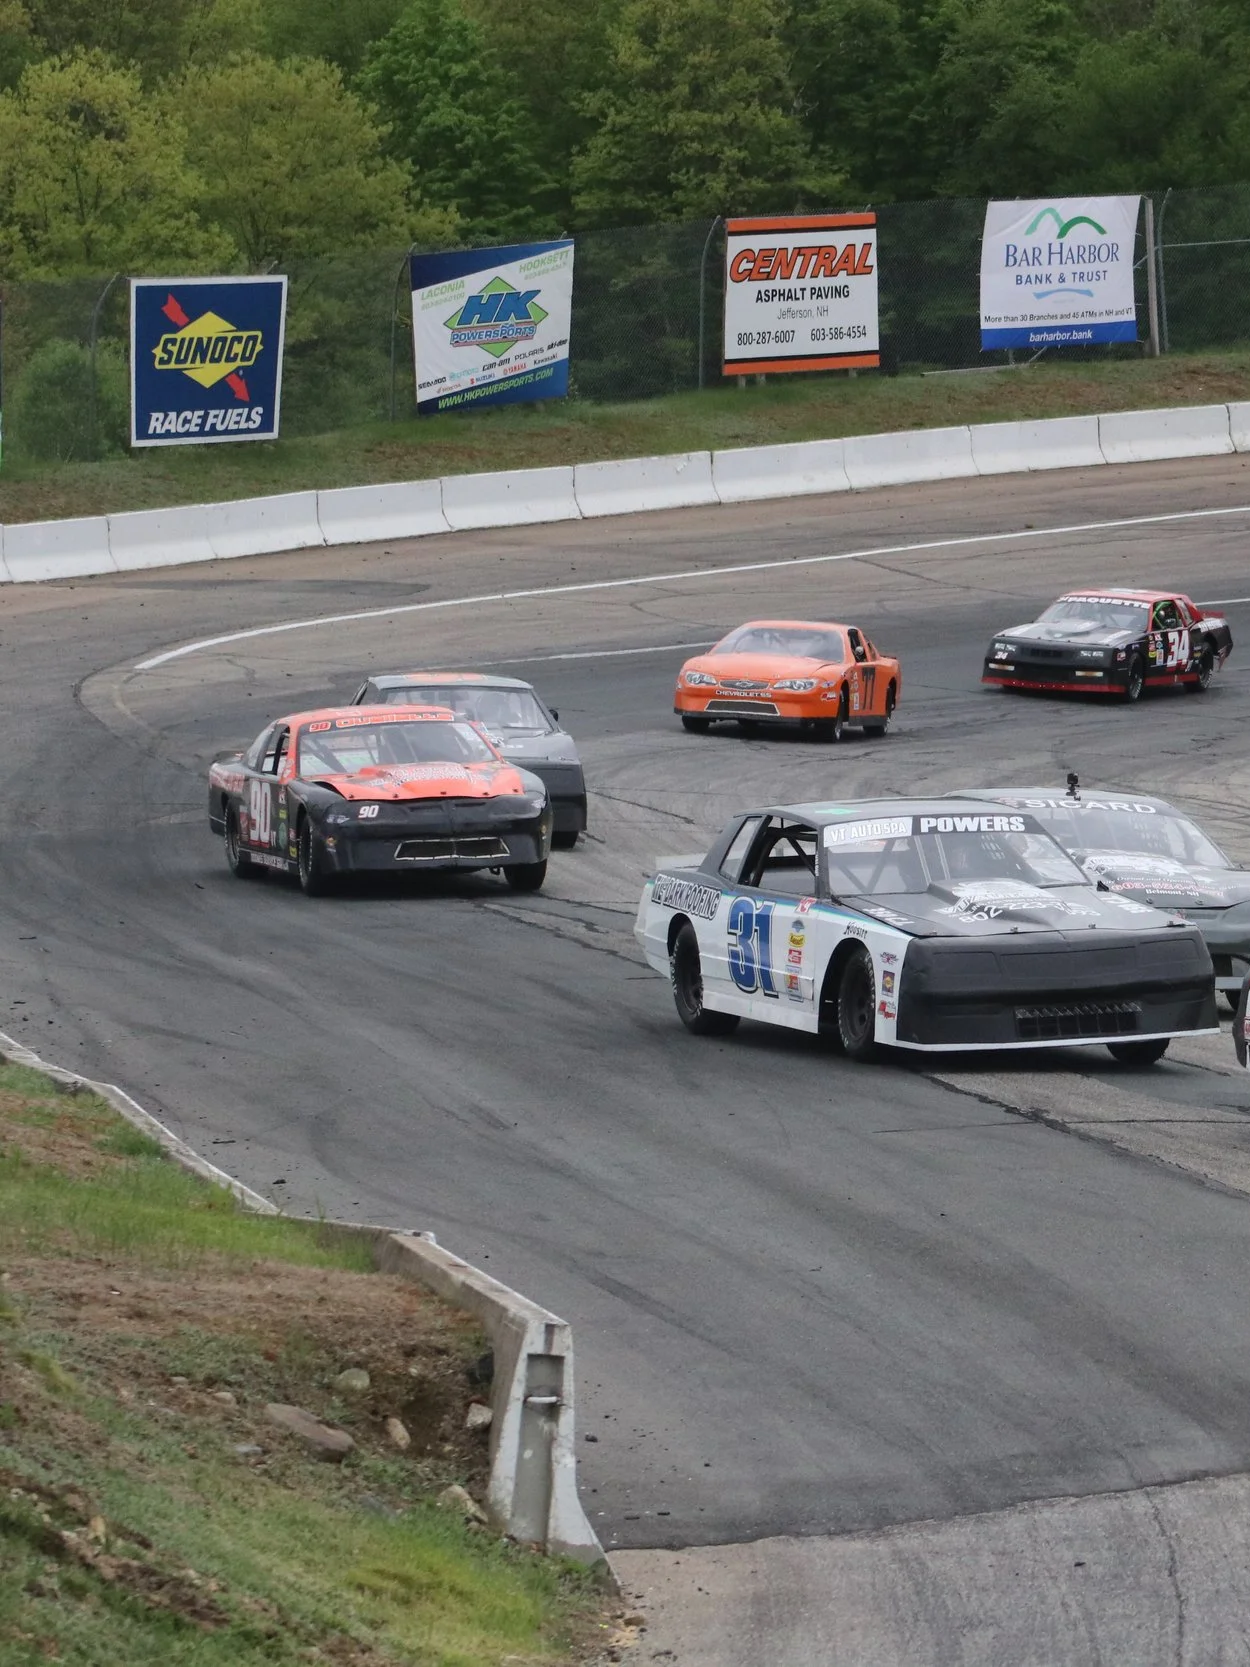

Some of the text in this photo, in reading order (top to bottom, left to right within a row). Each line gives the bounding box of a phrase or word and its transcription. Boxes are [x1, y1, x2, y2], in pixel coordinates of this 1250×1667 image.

[730, 242, 874, 283] CENTRAL
[1005, 242, 1120, 267] BAR HARBOR
[1015, 270, 1108, 286] BANK & TRUST
[421, 279, 465, 301] LACONIA
[755, 285, 850, 303] ASPHALT PAVING
[456, 289, 541, 321] HK
[777, 305, 829, 320] Jefferson, NH
[984, 315, 1002, 323] More
[1003, 315, 1019, 323] than
[1020, 314, 1028, 322] 30
[1029, 313, 1058, 321] Branches
[1059, 311, 1071, 320] and
[1072, 311, 1080, 319] 45
[1081, 310, 1097, 318] ATMs
[1105, 309, 1113, 317] NH
[1115, 308, 1124, 316] and
[451, 325, 536, 343] POWERSPORTS
[737, 325, 867, 346] 800-287-6007 603-586-4554
[1029, 329, 1093, 343] barharbor.bank
[157, 335, 260, 366] SUNOCO
[438, 367, 554, 410] WWW.HKPOWERSPORTS.COM
[148, 407, 263, 434] RACE FUELS
[1166, 630, 1190, 667] 34
[715, 689, 759, 698] CHEVROLET
[861, 666, 876, 710] 77
[309, 721, 332, 733] 90
[250, 780, 272, 843] 90
[358, 804, 380, 818] 90
[1025, 799, 1157, 814] SICARD
[920, 816, 1026, 833] POWERS
[830, 828, 846, 842] VT
[727, 896, 779, 998] 31
